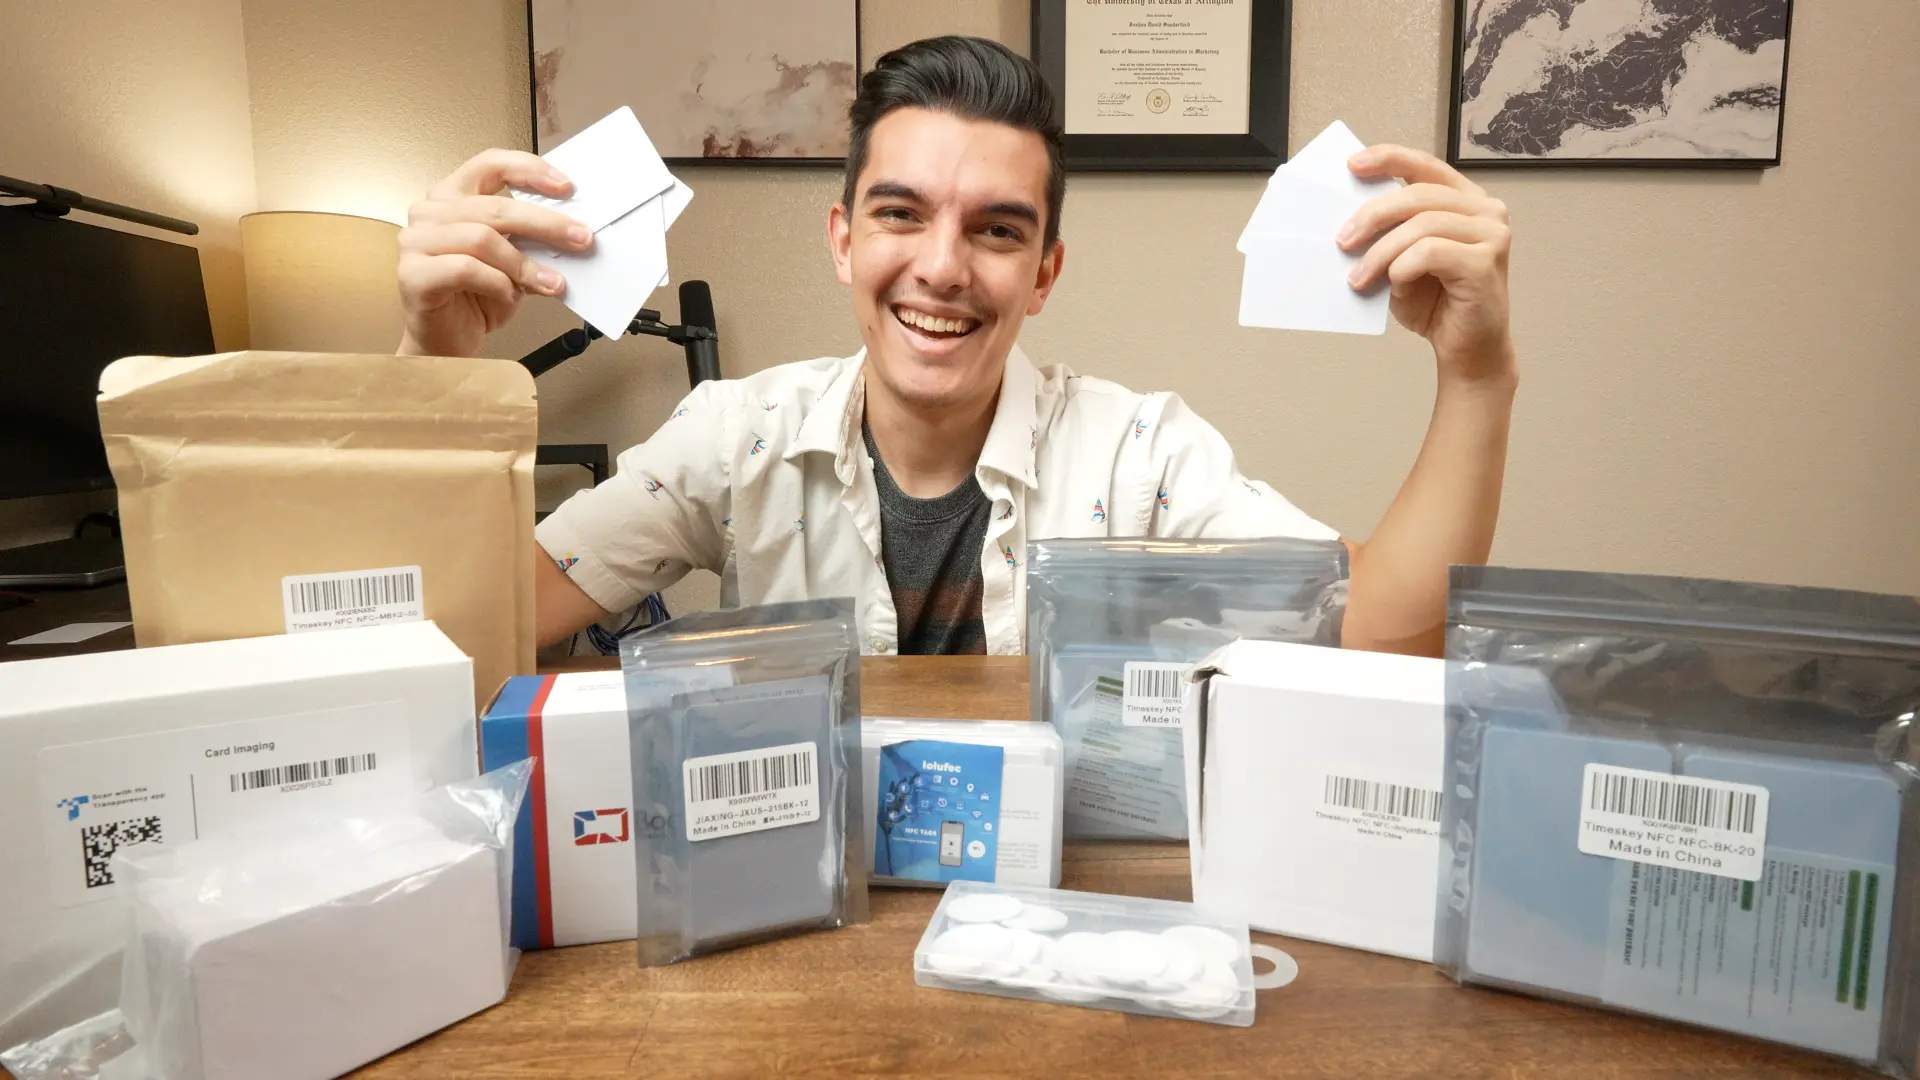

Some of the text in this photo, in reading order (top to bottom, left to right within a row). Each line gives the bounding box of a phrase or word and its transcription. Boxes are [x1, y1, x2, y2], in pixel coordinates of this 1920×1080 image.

[1142, 715, 1180, 724] Made in
[205, 740, 275, 758] Card Imaging
[92, 786, 148, 801] Scan with the
[152, 792, 166, 802] app
[693, 818, 756, 836] Made in China
[1584, 821, 1756, 857] Timeskey NFC NFC-BK-20
[1609, 838, 1722, 868] Made in China
